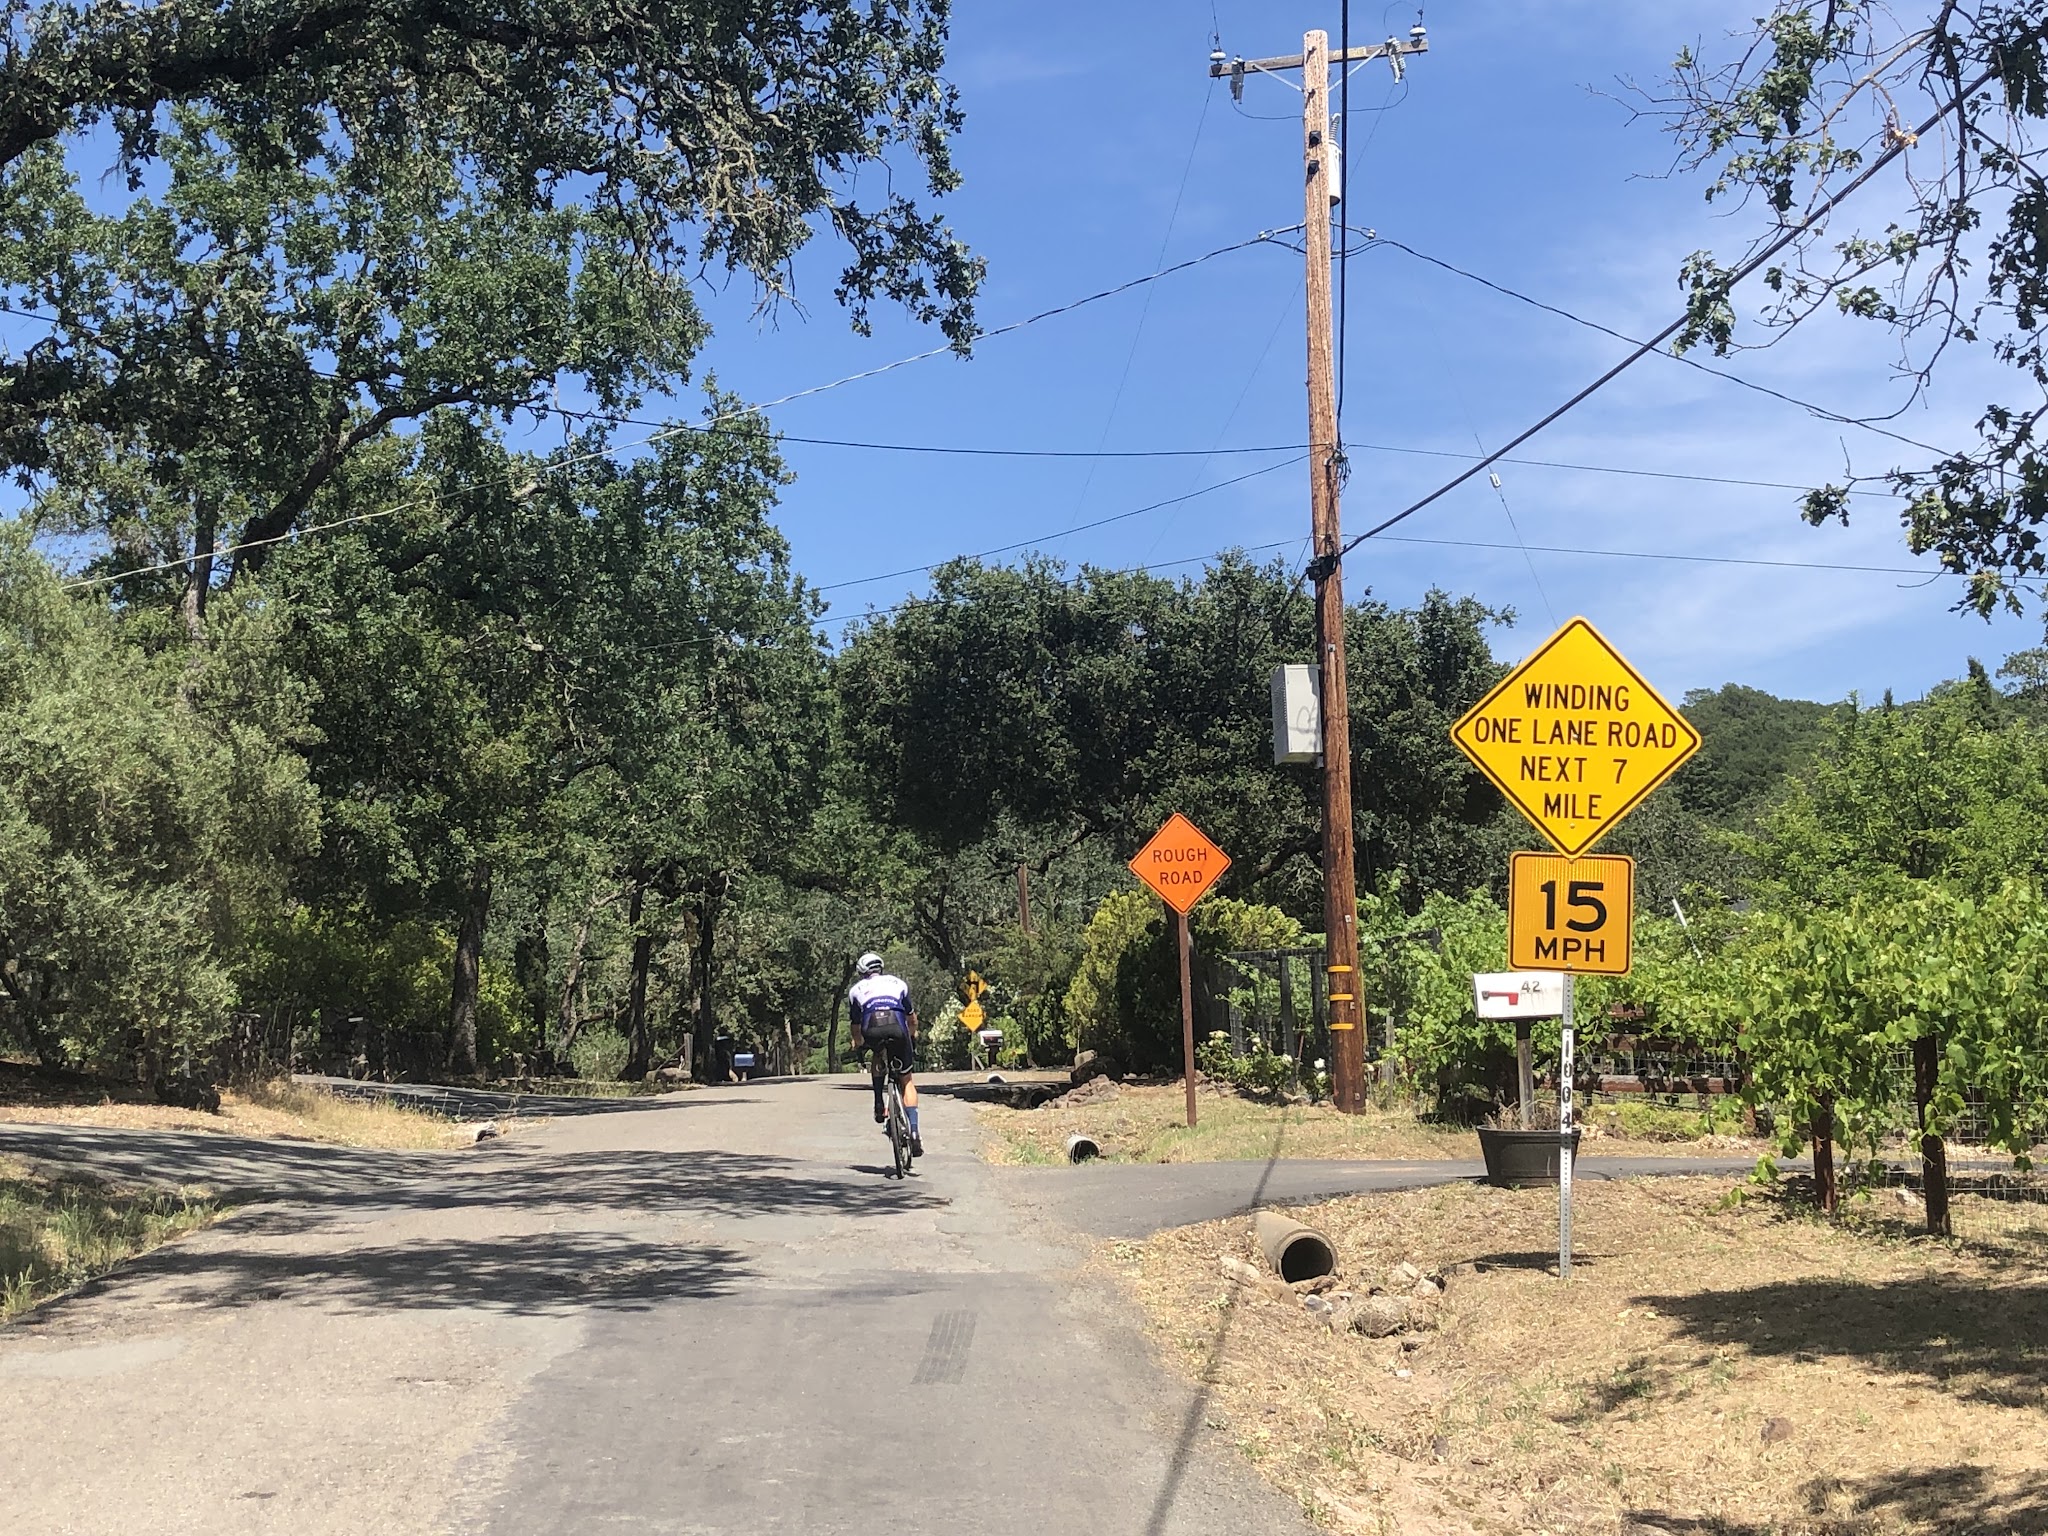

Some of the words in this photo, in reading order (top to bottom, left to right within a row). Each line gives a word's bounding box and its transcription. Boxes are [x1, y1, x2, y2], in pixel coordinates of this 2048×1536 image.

[1524, 683, 1630, 711] WINDING
[1474, 717, 1522, 744] ONE
[1533, 719, 1598, 746] LANE
[1607, 721, 1677, 749] ROAD
[1520, 755, 1587, 783] NEXT
[1612, 758, 1628, 784] 7
[1543, 793, 1602, 820] MILE
[1152, 848, 1208, 863] ROUGH
[1160, 870, 1203, 885] ROAD
[1540, 880, 1607, 933] 15
[1534, 936, 1605, 962] MPH
[1521, 980, 1541, 993] 42
